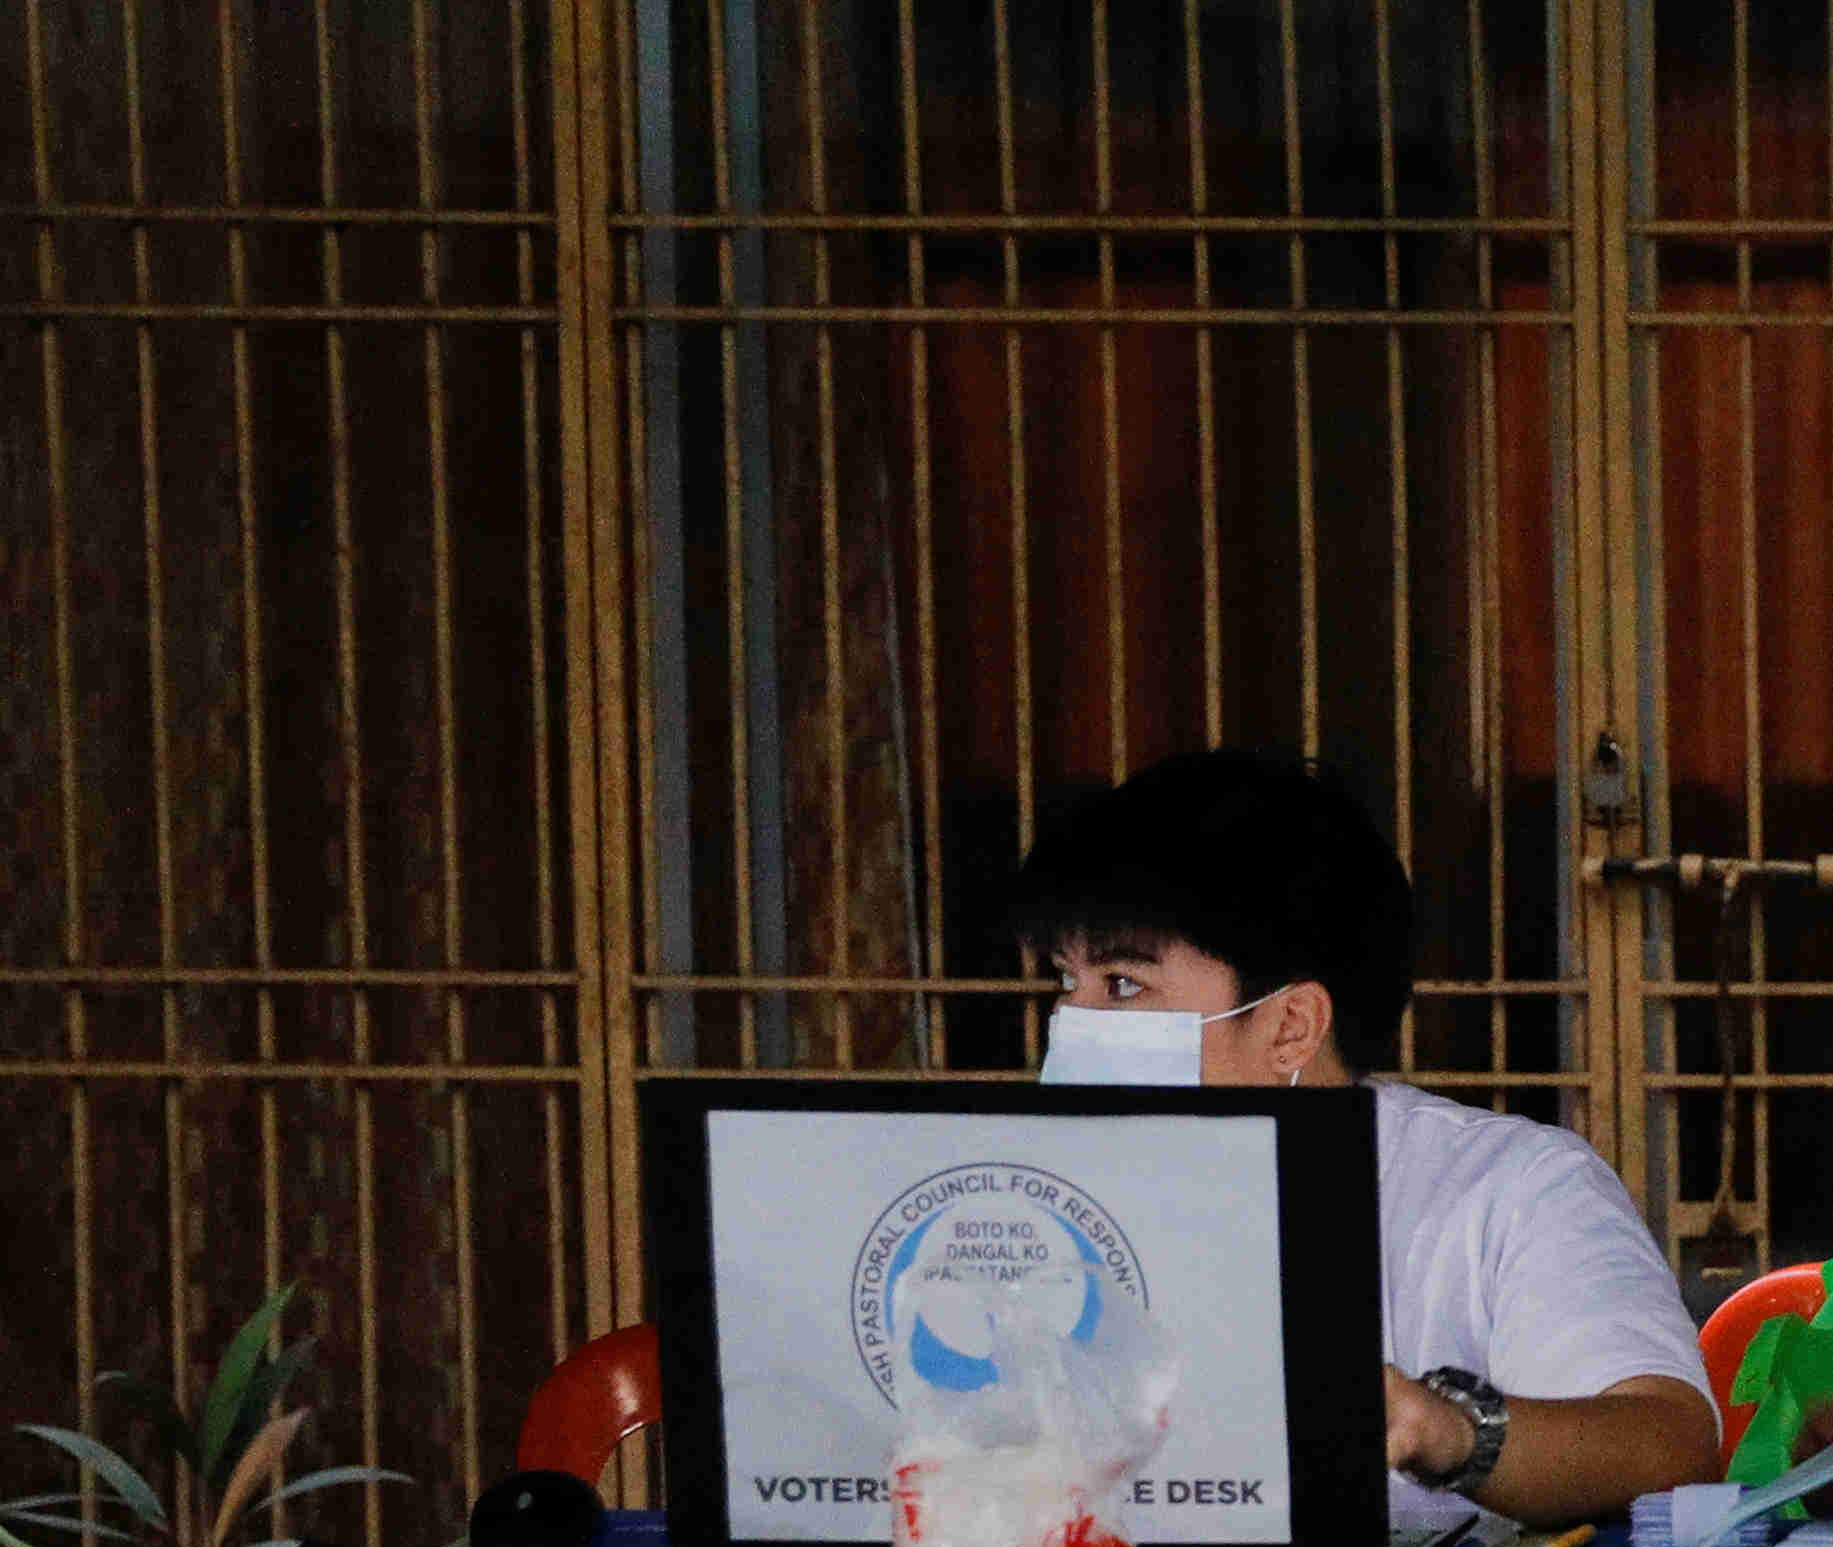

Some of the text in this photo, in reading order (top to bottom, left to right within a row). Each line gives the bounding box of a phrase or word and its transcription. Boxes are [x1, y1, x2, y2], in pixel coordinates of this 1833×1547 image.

[954, 1221, 1003, 1239] BOTO
[861, 1174, 1137, 1348] PASTORAL COUNCIL FOR RESPON
[946, 1243, 1049, 1261] DANGAL KO
[754, 1476, 891, 1502] VOTER
[1167, 1479, 1265, 1505] DESK
